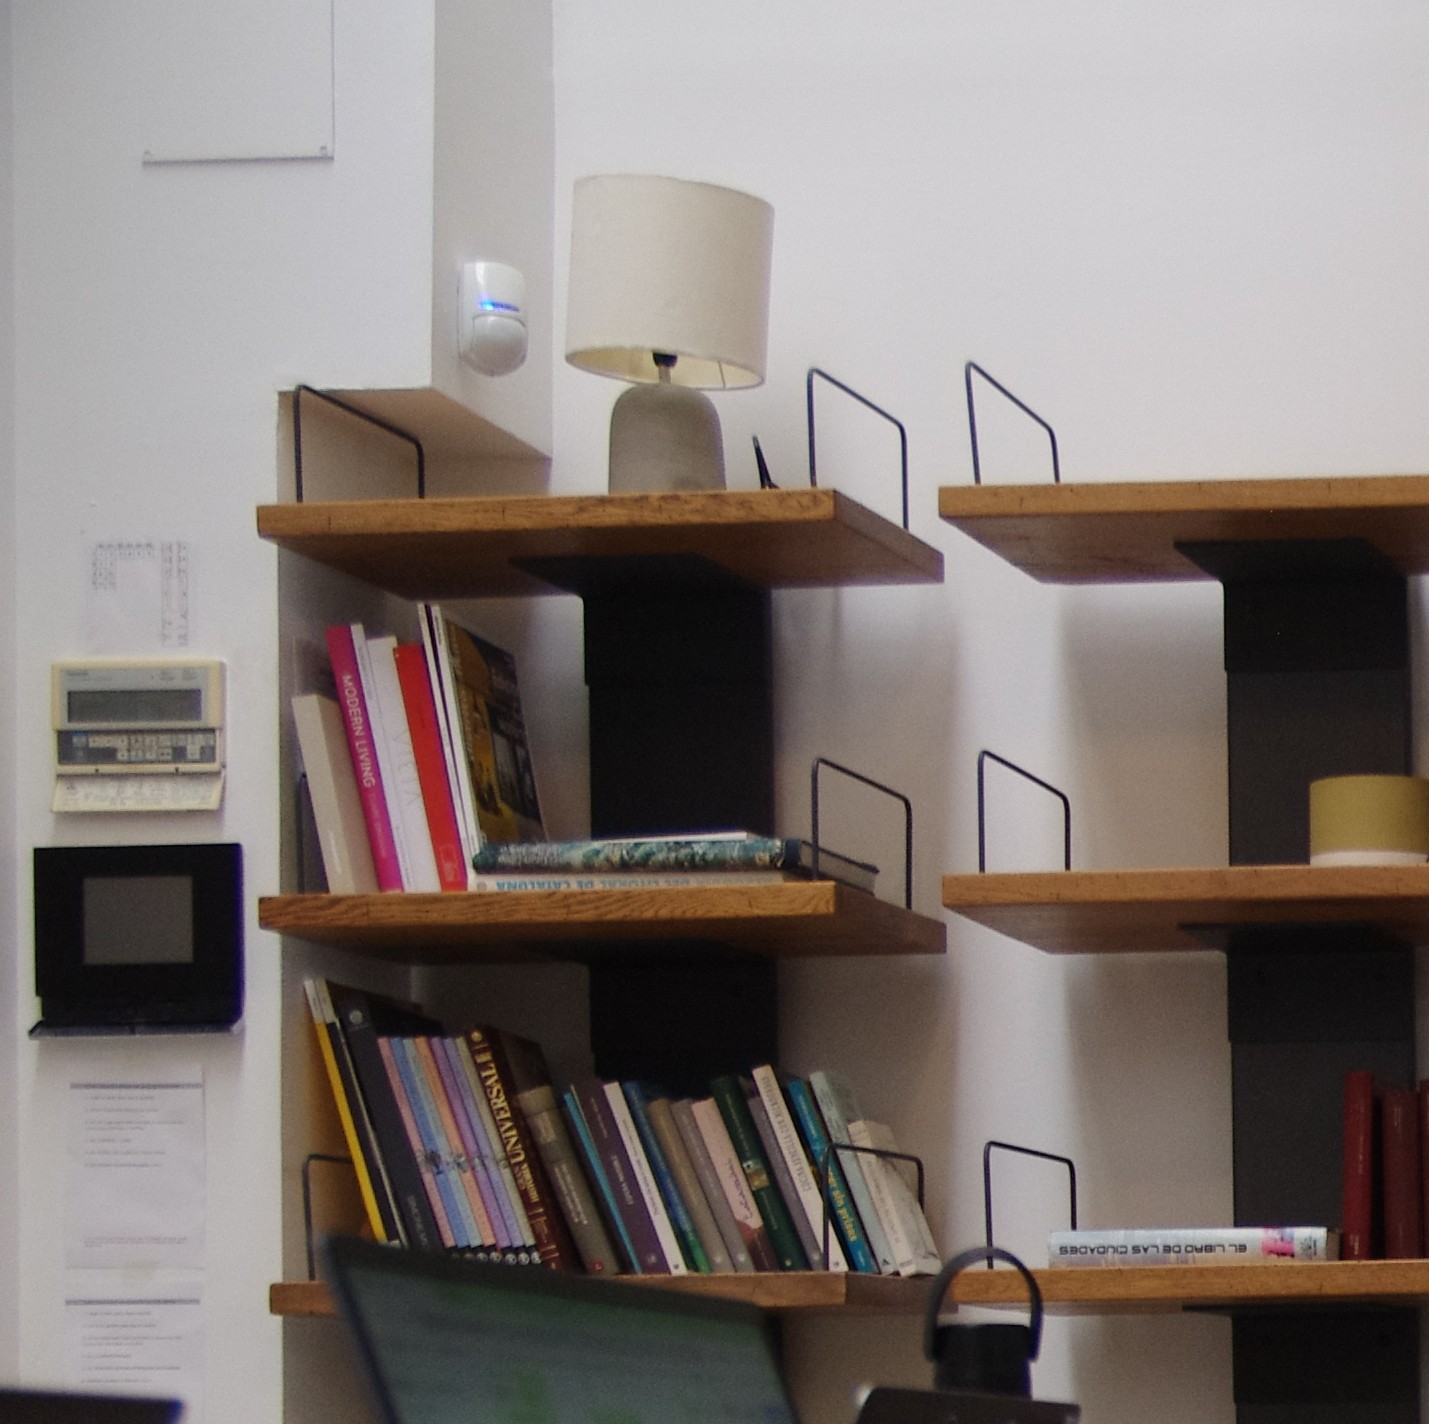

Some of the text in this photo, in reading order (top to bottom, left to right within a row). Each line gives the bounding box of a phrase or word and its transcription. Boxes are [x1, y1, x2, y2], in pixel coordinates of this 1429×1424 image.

[342, 674, 365, 737] MODERN
[355, 738, 376, 789] LIVING
[480, 1060, 526, 1164] UNIVERSAL
[1058, 1244, 1247, 1255] EL LIBRO DE LAS CIUDADES
